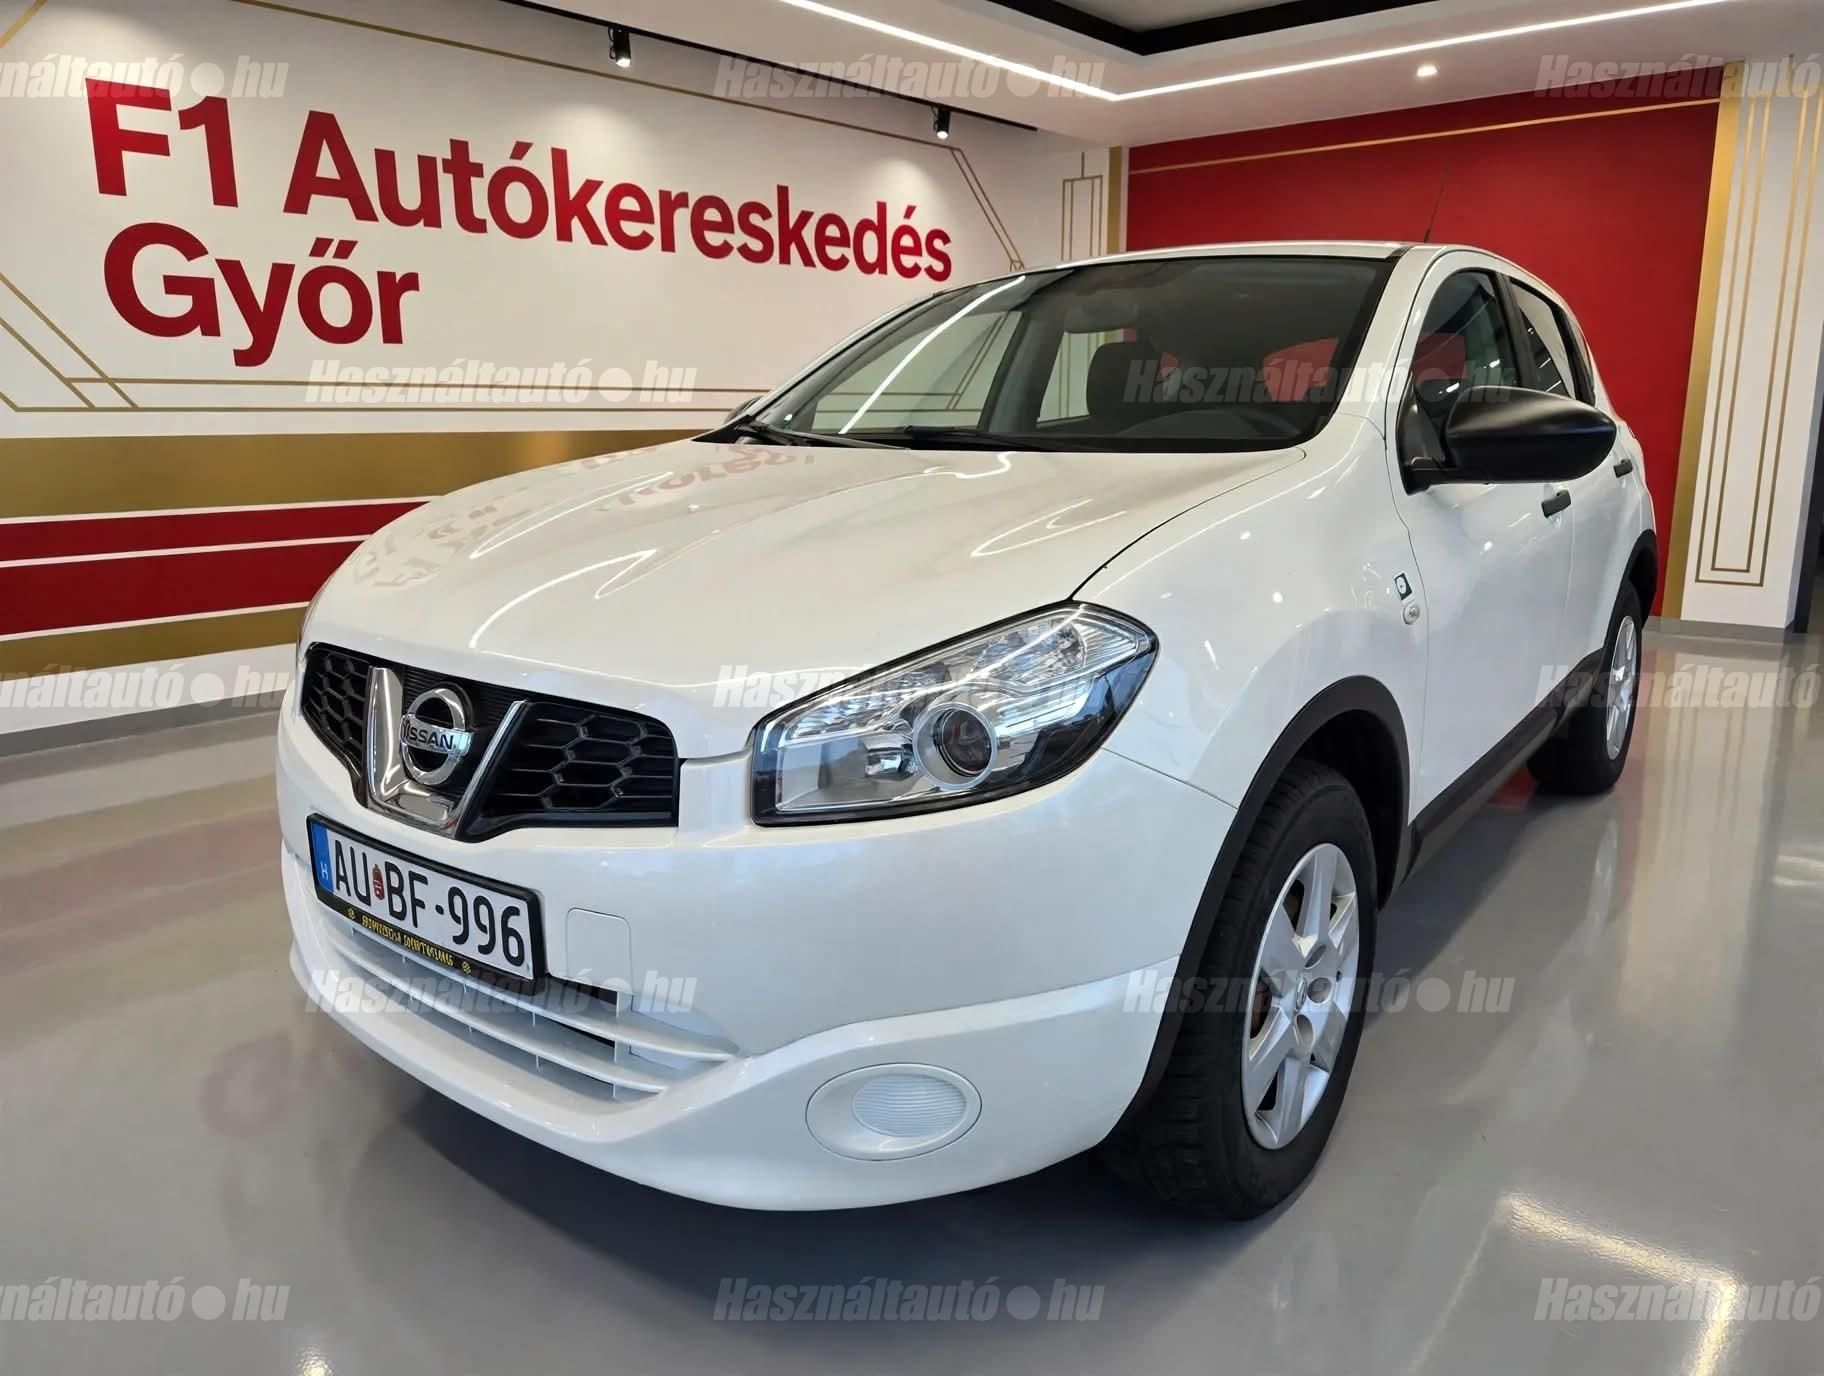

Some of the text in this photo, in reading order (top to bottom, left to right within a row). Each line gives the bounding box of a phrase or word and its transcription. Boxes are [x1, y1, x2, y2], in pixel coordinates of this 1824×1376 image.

[86, 78, 952, 282] F1 Autókereskedés
[104, 222, 420, 367] Győr
